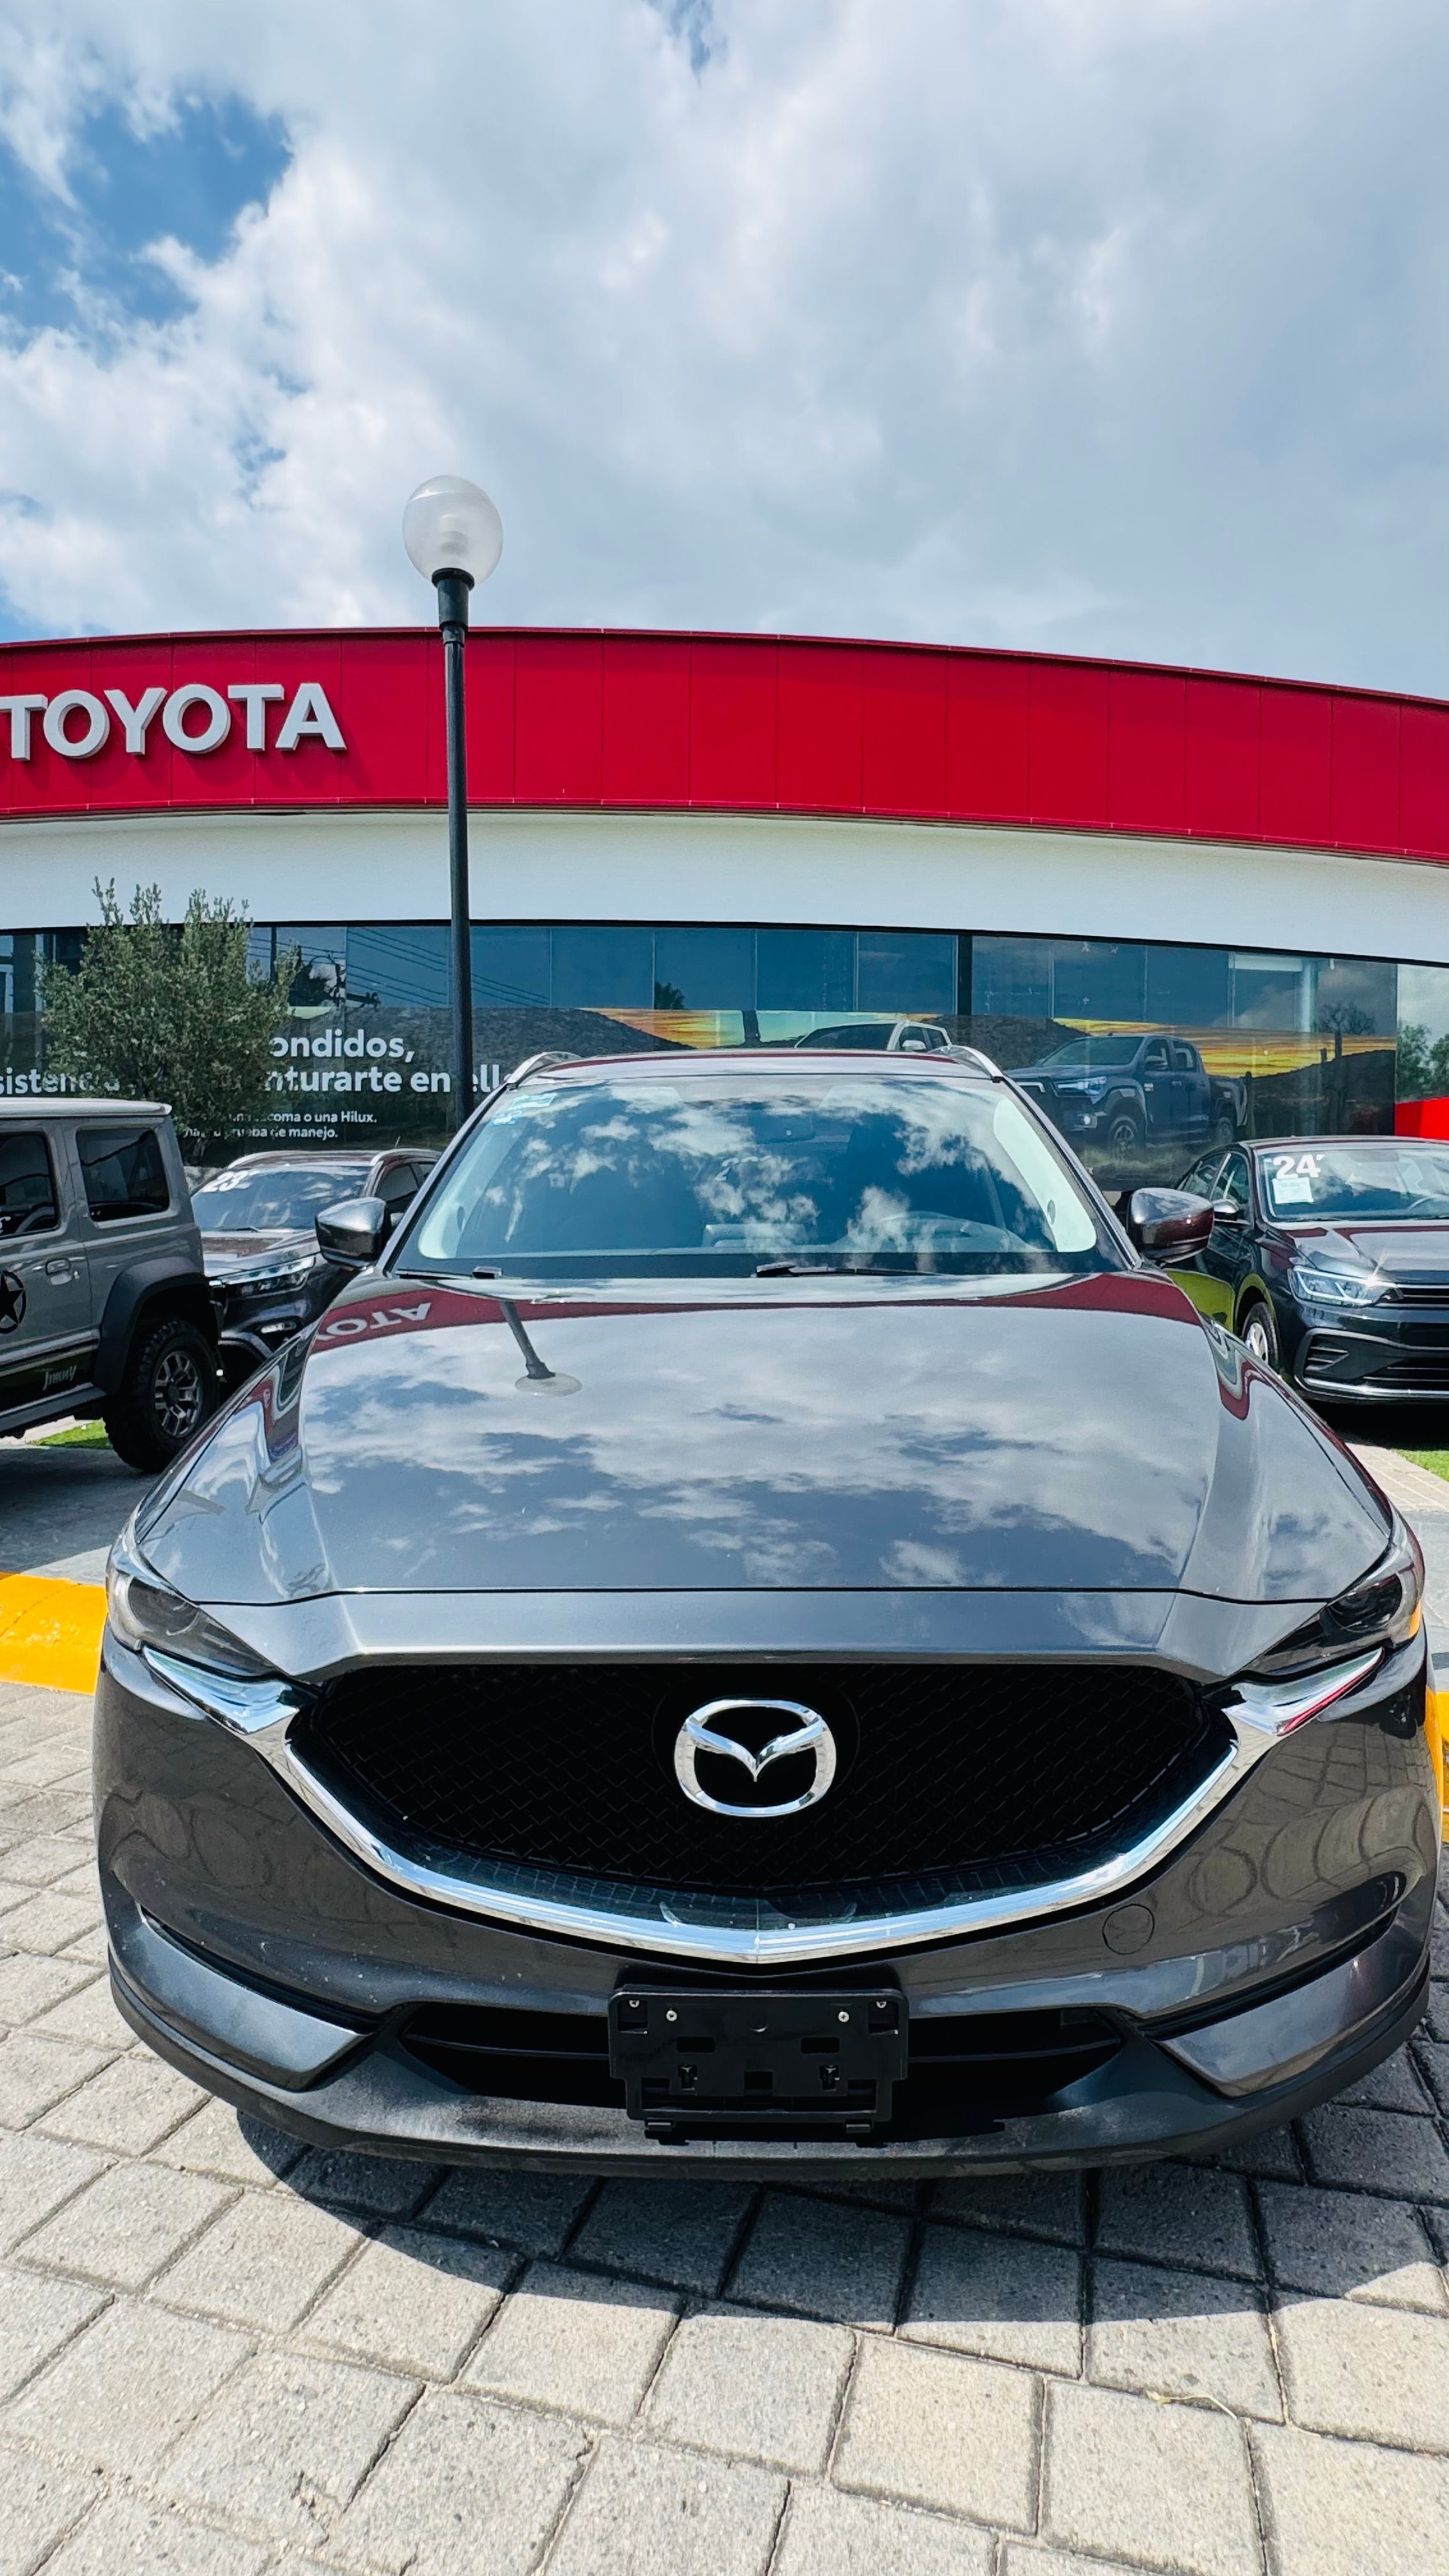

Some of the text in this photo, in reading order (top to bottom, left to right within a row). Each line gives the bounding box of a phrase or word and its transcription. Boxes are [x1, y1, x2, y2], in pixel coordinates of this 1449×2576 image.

[0, 683, 347, 760] TOYOTA
[269, 1029, 415, 1062] ondidos,
[265, 1066, 402, 1092] nturarte
[410, 1072, 451, 1092] en
[303, 1113, 312, 1123] o
[314, 1113, 338, 1123] una
[341, 1110, 378, 1123] Hilux.
[288, 1126, 339, 1140] manejo.
